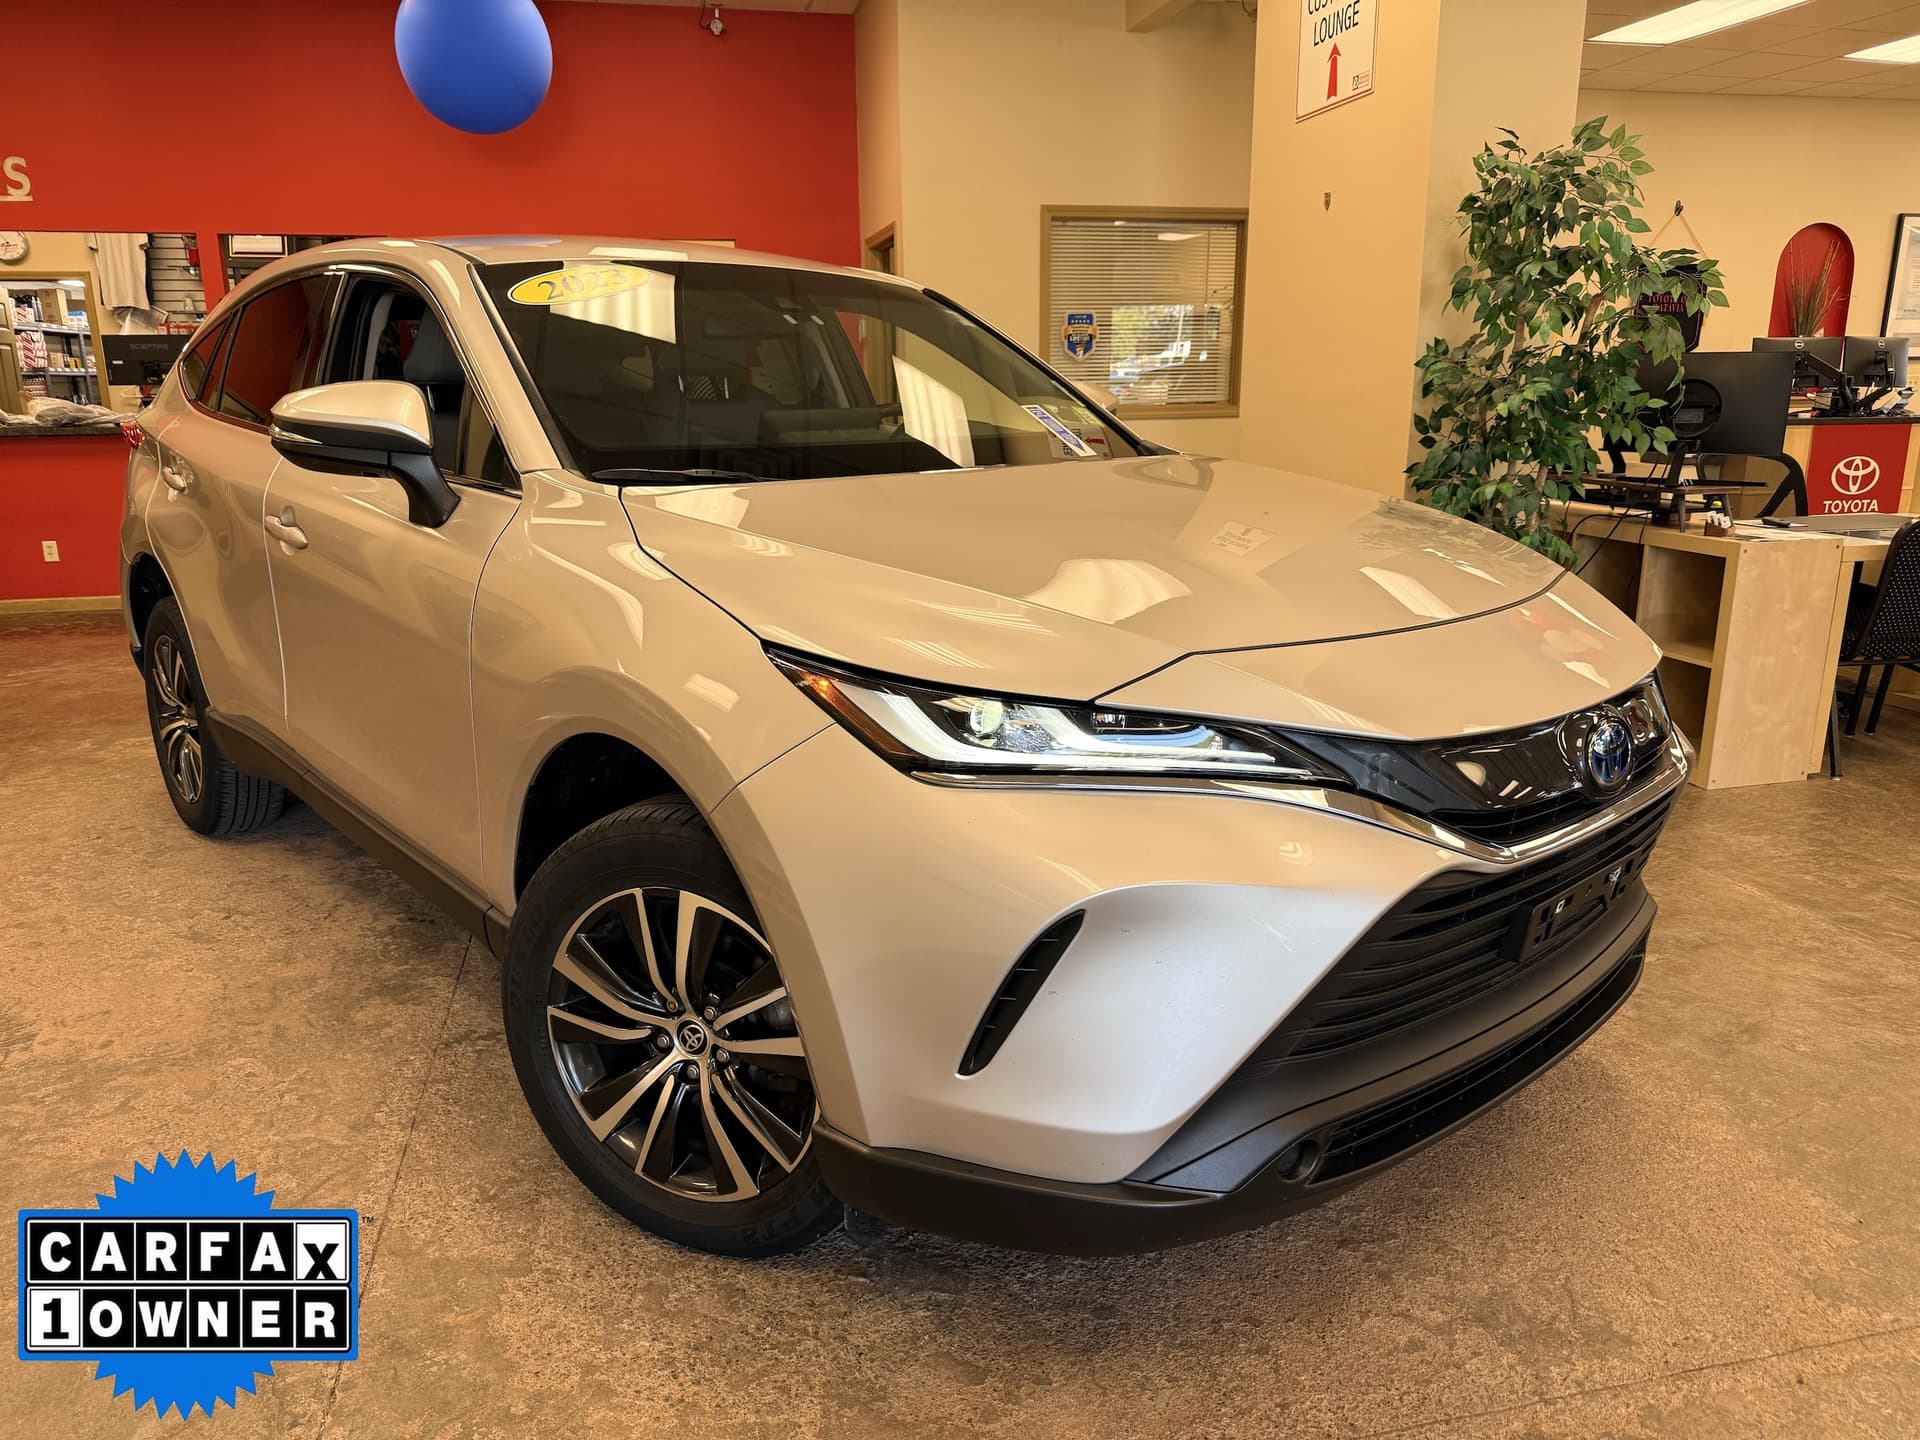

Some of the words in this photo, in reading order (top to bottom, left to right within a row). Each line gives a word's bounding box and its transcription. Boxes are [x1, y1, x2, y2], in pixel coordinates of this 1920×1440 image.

[1313, 0, 1360, 47] LOUNGE
[537, 268, 629, 300] 2023
[1648, 294, 1678, 304] TOYOT
[1823, 499, 1879, 514] TOYOTA
